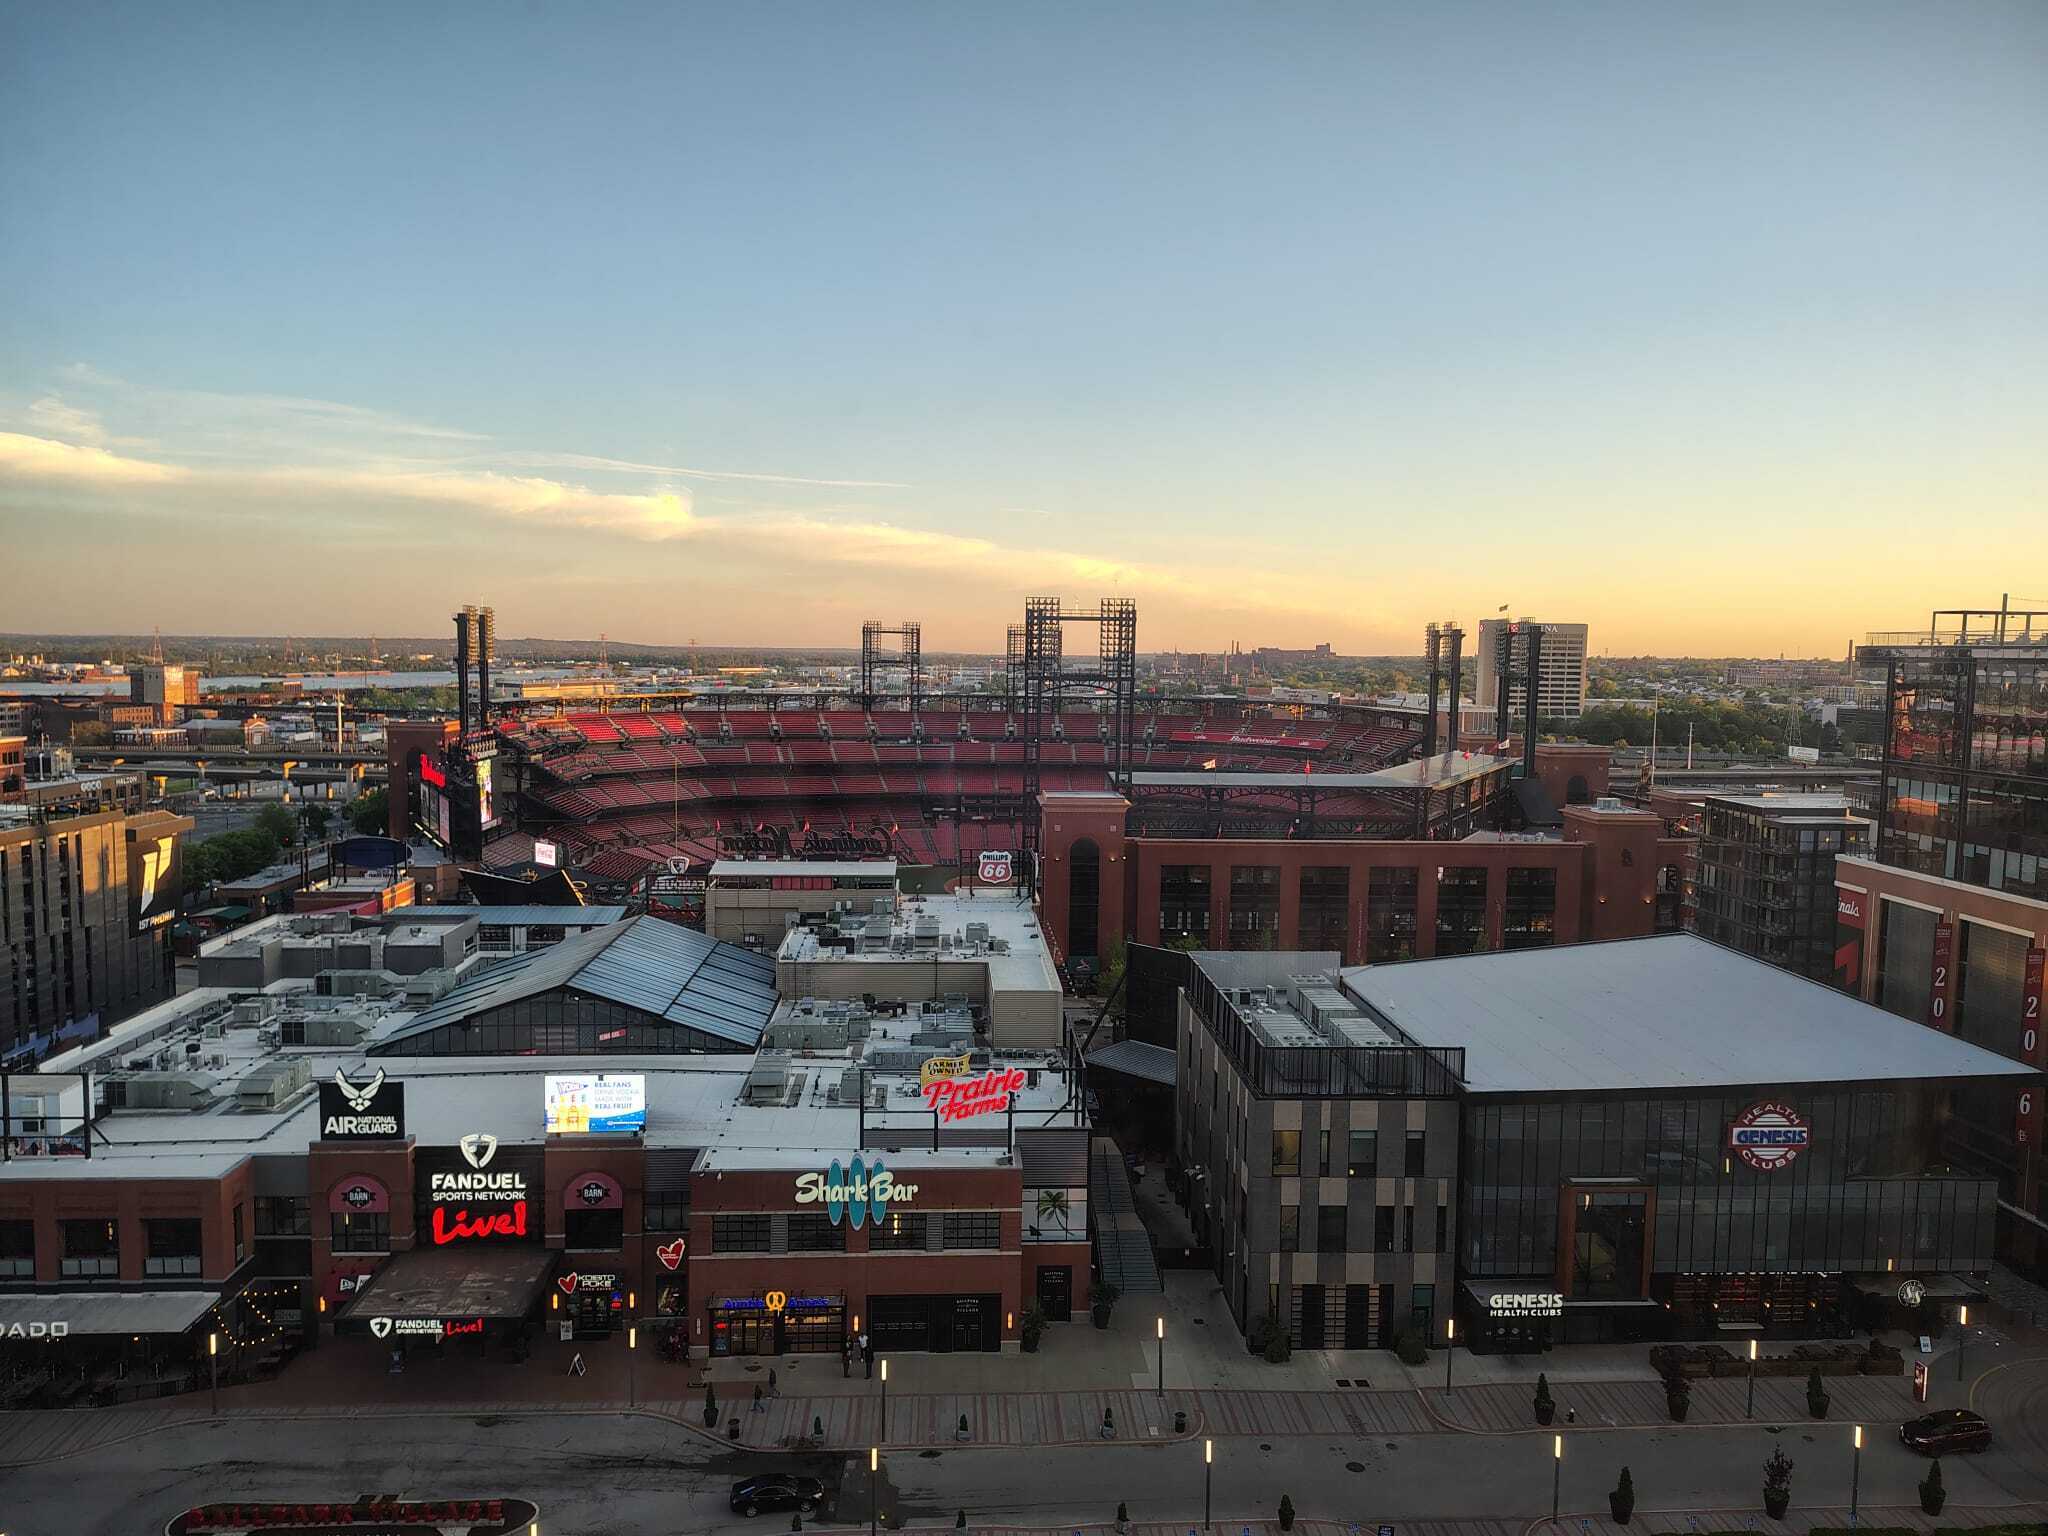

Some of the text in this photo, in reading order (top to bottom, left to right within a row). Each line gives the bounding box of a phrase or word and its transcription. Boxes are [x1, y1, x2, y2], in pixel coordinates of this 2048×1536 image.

[983, 863, 1007, 878] 66
[927, 1060, 965, 1071] FARMER
[928, 1067, 963, 1076] OWNED
[921, 1066, 1026, 1109] Prairie
[938, 1094, 1010, 1124] Farms
[1742, 1103, 1801, 1125] HEALTH
[324, 1116, 357, 1135] AIR
[357, 1116, 397, 1124] NATIONAL
[356, 1123, 397, 1135] GUARD
[1737, 1130, 1807, 1144] GENESIS
[1742, 1149, 1797, 1169] CLUBS
[431, 1173, 527, 1190] FANDUEL
[795, 1171, 919, 1204] Shark Bar
[348, 1191, 369, 1201] BARN
[432, 1191, 527, 1201] SPORTS NETWORK
[584, 1188, 603, 1198] BARN
[431, 1200, 528, 1245] Live!
[582, 1280, 612, 1288] POKE
[1490, 1294, 1564, 1309] GENESIS
[1490, 1309, 1563, 1317] HEALTH CLUBS
[395, 1318, 484, 1336] FANDUEL Live!
